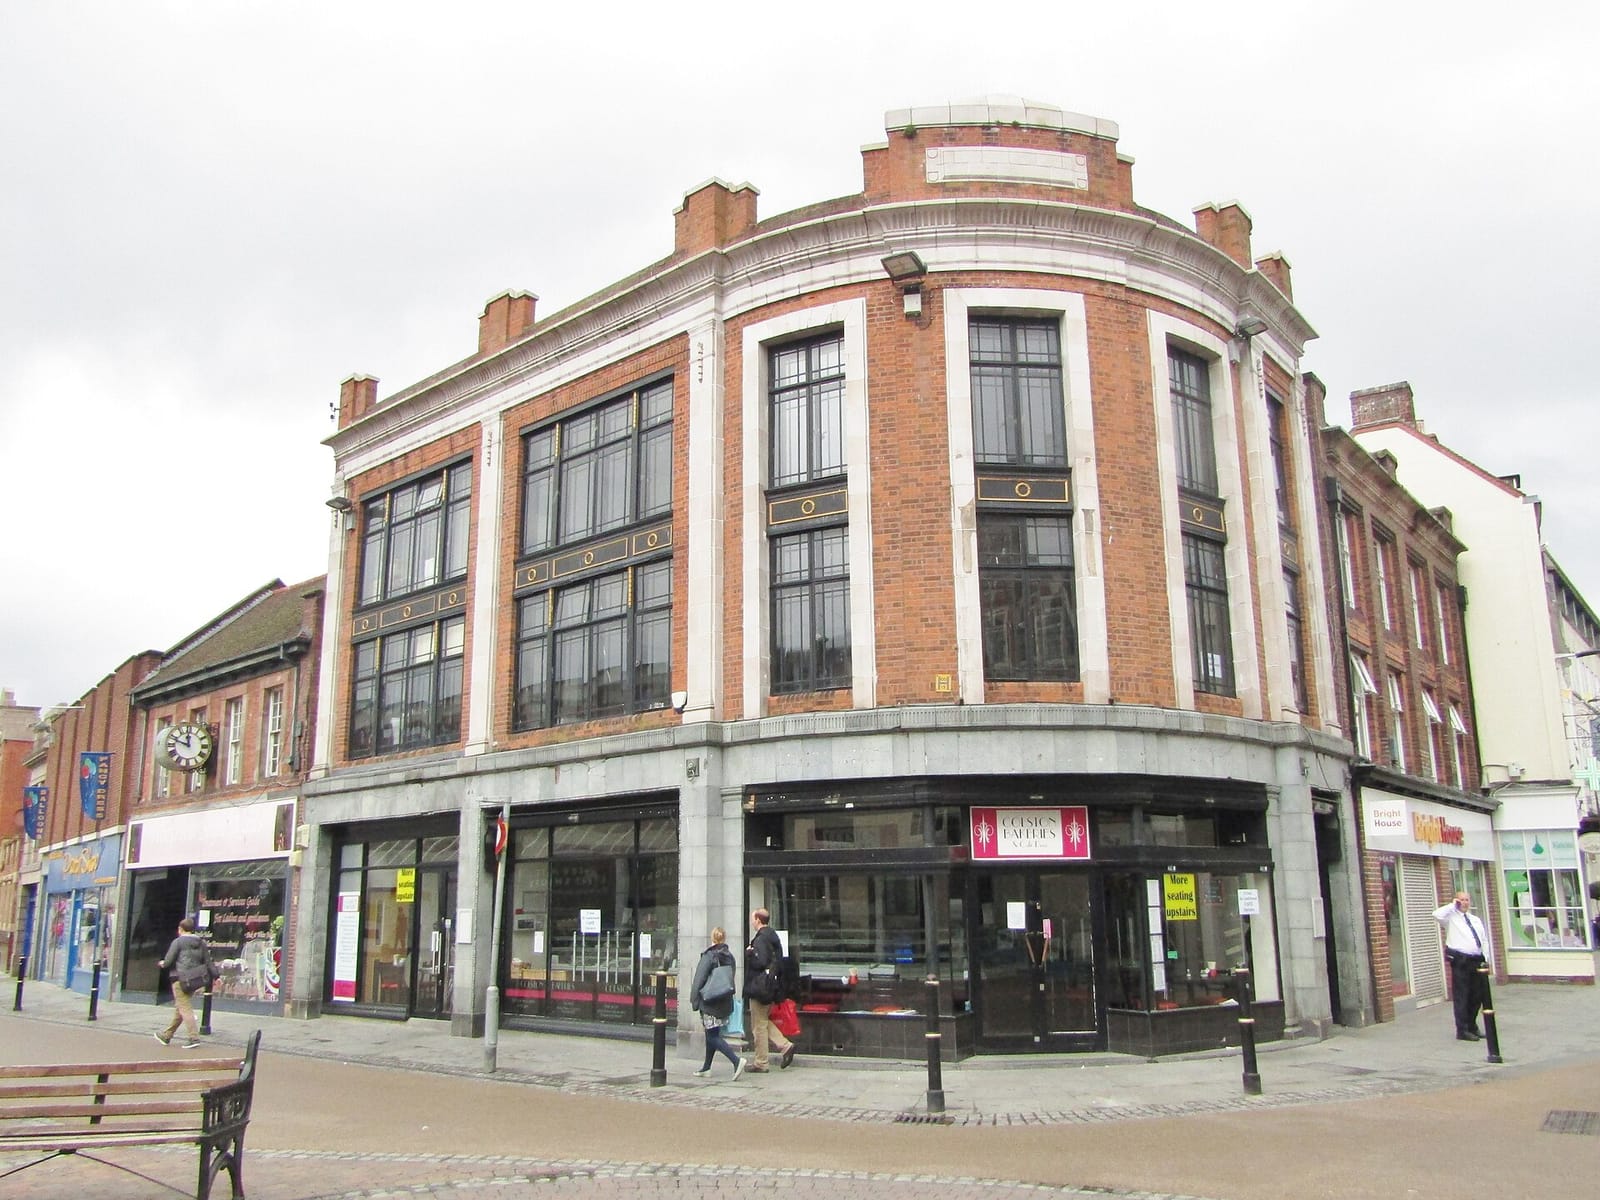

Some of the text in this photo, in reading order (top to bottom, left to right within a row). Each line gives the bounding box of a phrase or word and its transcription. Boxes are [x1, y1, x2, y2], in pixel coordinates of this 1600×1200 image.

[36, 789, 48, 840] BALLOONS
[1373, 809, 1401, 818] Bright
[1002, 816, 1057, 828] COLSTON
[1374, 819, 1402, 828] House
[1003, 828, 1056, 840] BAKERIES
[401, 868, 413, 877] More
[1169, 875, 1188, 885] More
[1167, 890, 1193, 902] seating
[1166, 907, 1196, 918] upstairs
